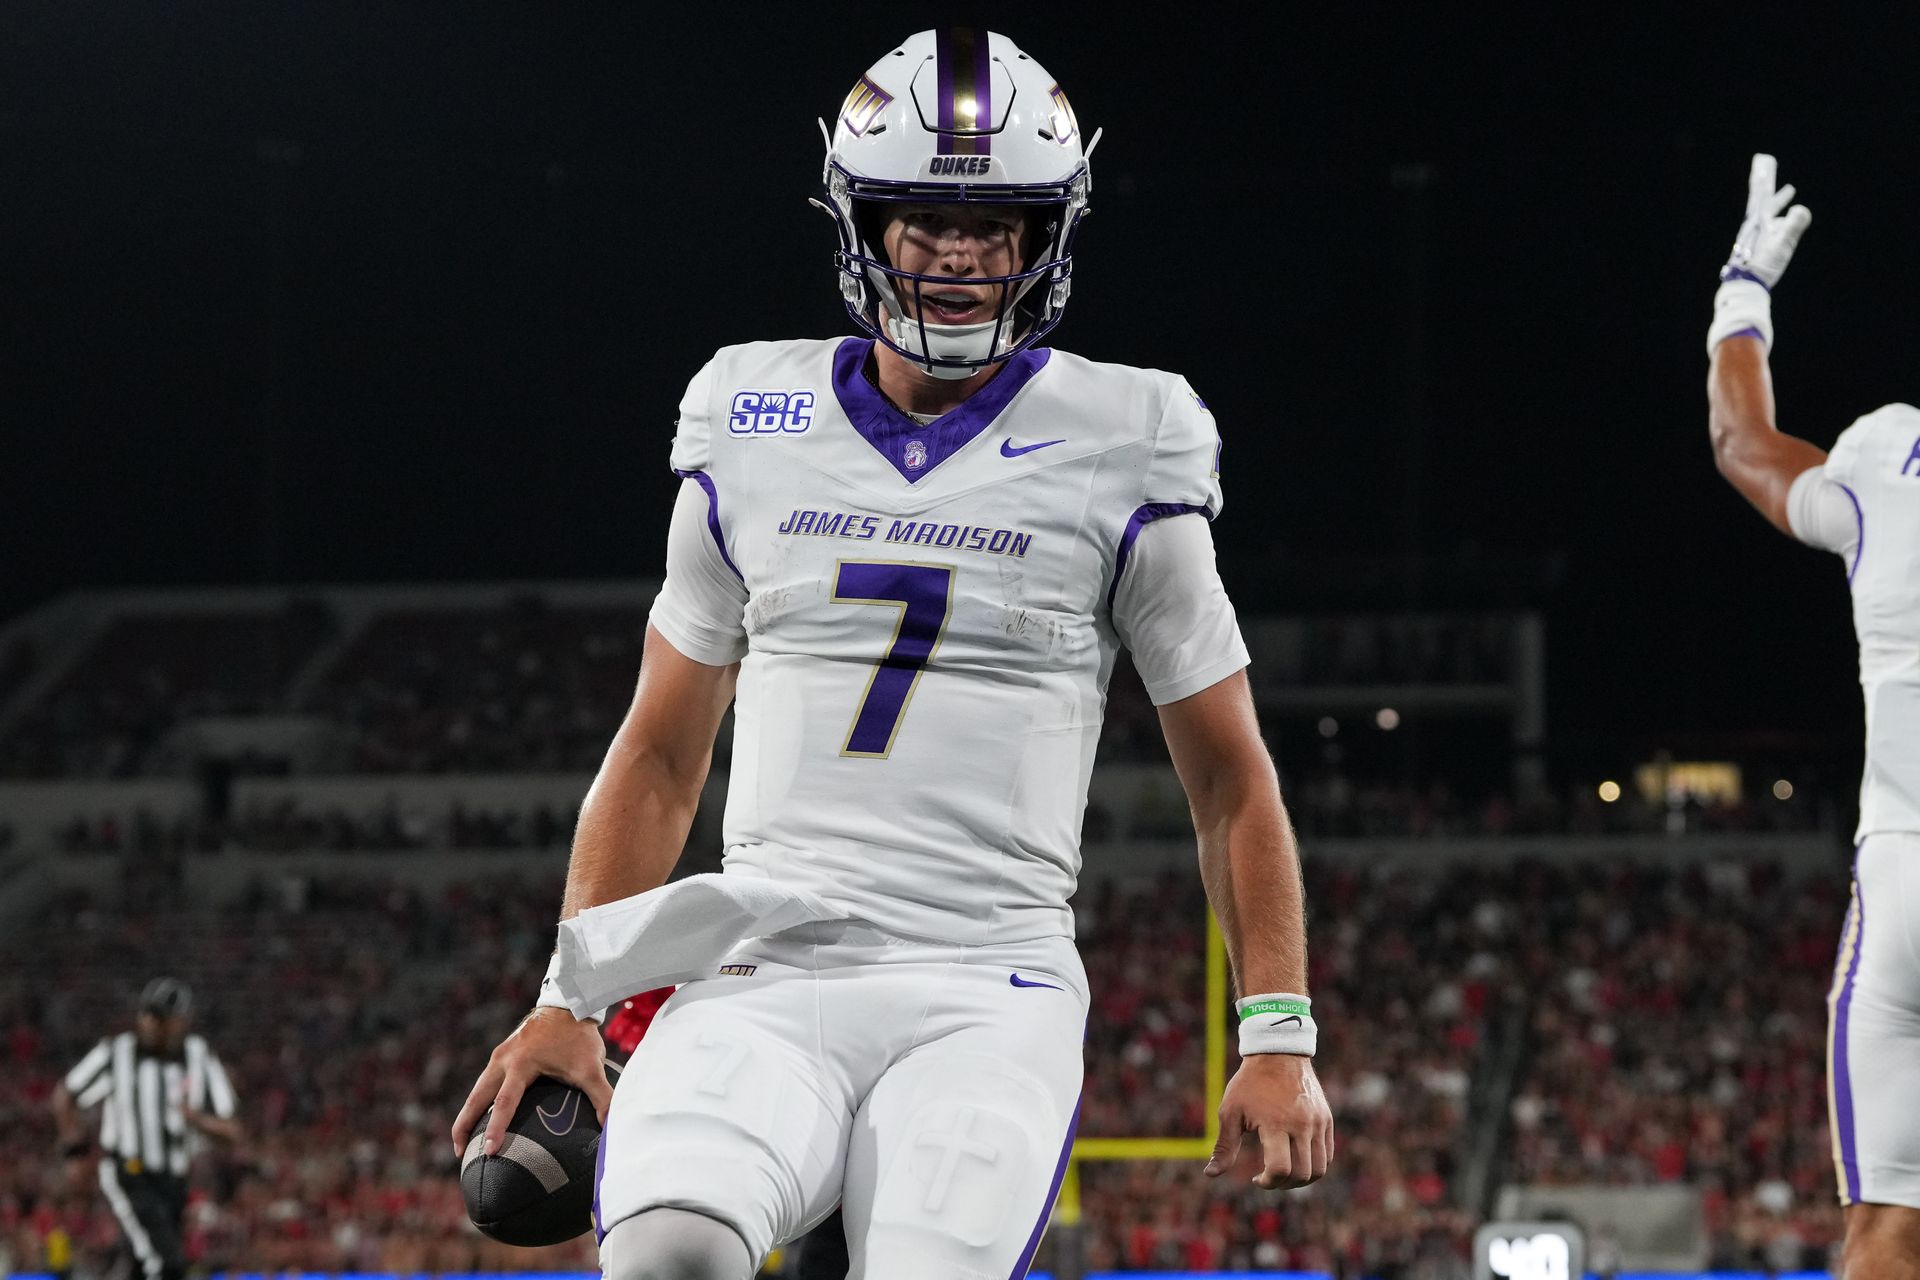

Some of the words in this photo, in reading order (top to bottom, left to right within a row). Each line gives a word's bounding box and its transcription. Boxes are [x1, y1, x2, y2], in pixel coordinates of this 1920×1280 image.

[929, 157, 991, 176] DUKES
[728, 390, 815, 434] SBC
[777, 509, 882, 540] JAMES
[884, 519, 1036, 557] MADISON
[829, 558, 957, 760] 7
[1249, 1003, 1277, 1013] PAUL
[1278, 1003, 1301, 1012] JOHN
